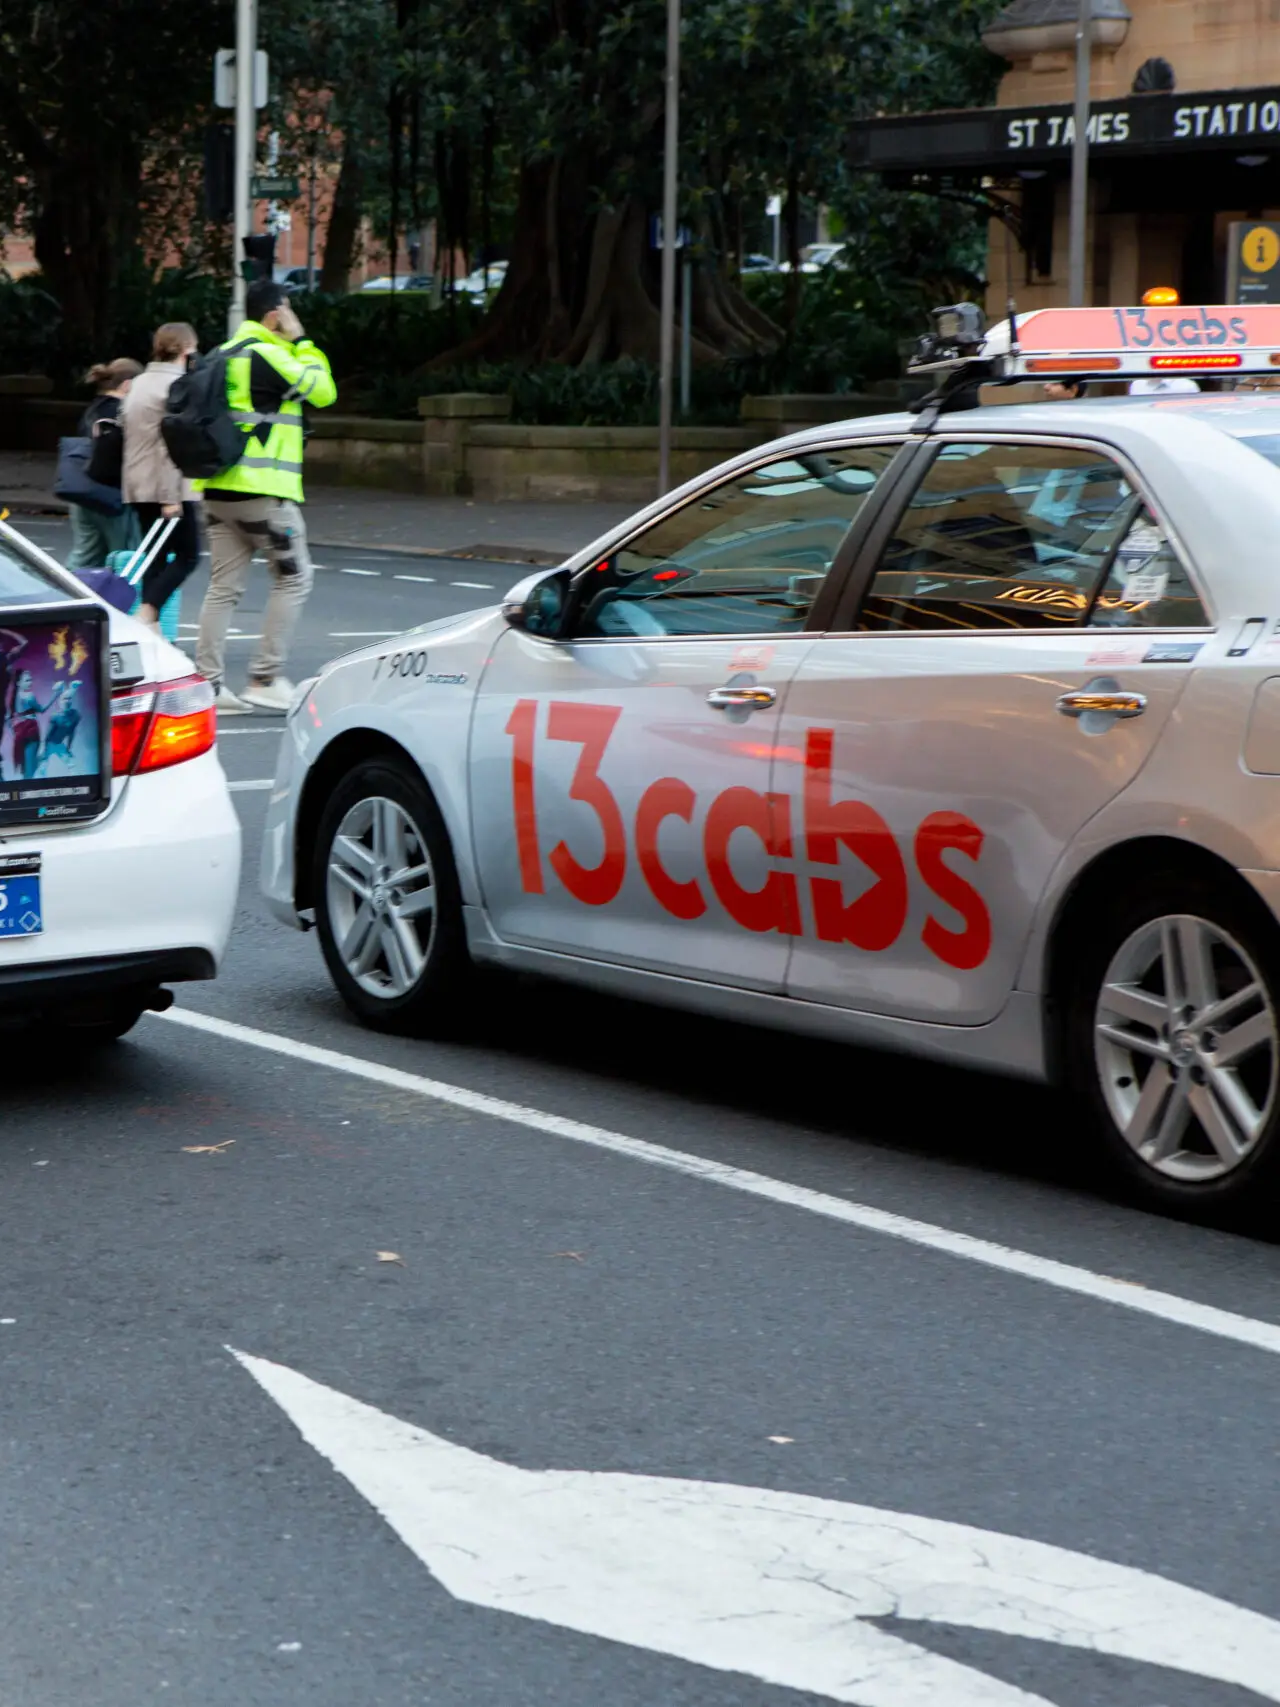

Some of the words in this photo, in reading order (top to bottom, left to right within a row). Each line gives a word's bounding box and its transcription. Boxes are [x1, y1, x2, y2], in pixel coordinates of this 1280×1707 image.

[1008, 118, 1039, 148] ST
[1046, 111, 1130, 146] JAMES
[1174, 99, 1280, 138] STATIO
[1113, 307, 1248, 348] 13cabs
[372, 655, 387, 681] T
[388, 651, 428, 678] 900
[505, 697, 993, 971] 13cabs
